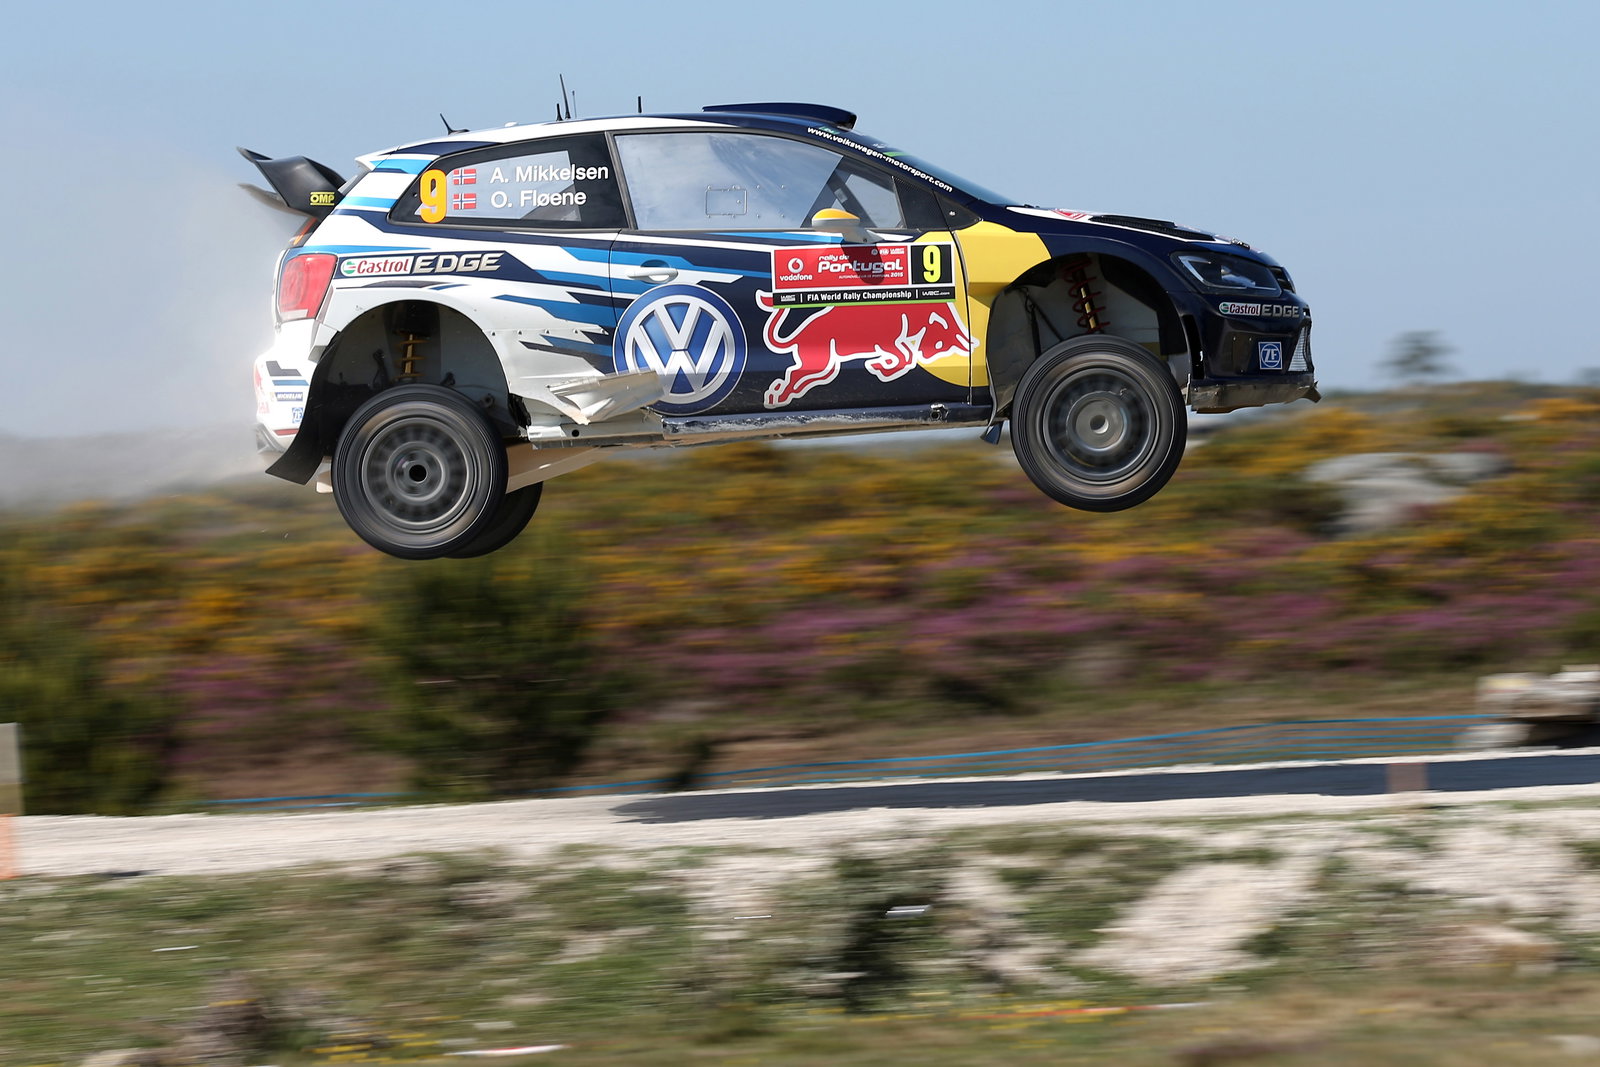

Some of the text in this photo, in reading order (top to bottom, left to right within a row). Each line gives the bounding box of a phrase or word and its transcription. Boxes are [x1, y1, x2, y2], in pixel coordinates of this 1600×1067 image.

[807, 127, 953, 193] www.volkswagen-motorsport.com
[490, 164, 609, 183] A. Mikkelsen
[310, 193, 335, 204] OMP
[419, 168, 448, 224] 9
[490, 190, 587, 208] O. Fløene
[356, 252, 505, 274] Castrol EDGE
[817, 259, 904, 274] Portugal
[922, 245, 942, 283] 9
[780, 274, 813, 282] vodafone
[820, 293, 842, 301] World
[843, 292, 861, 301] Rally
[862, 290, 912, 300] Championship
[1229, 303, 1300, 317] Castrol EDGE
[1263, 347, 1280, 363] ZF
